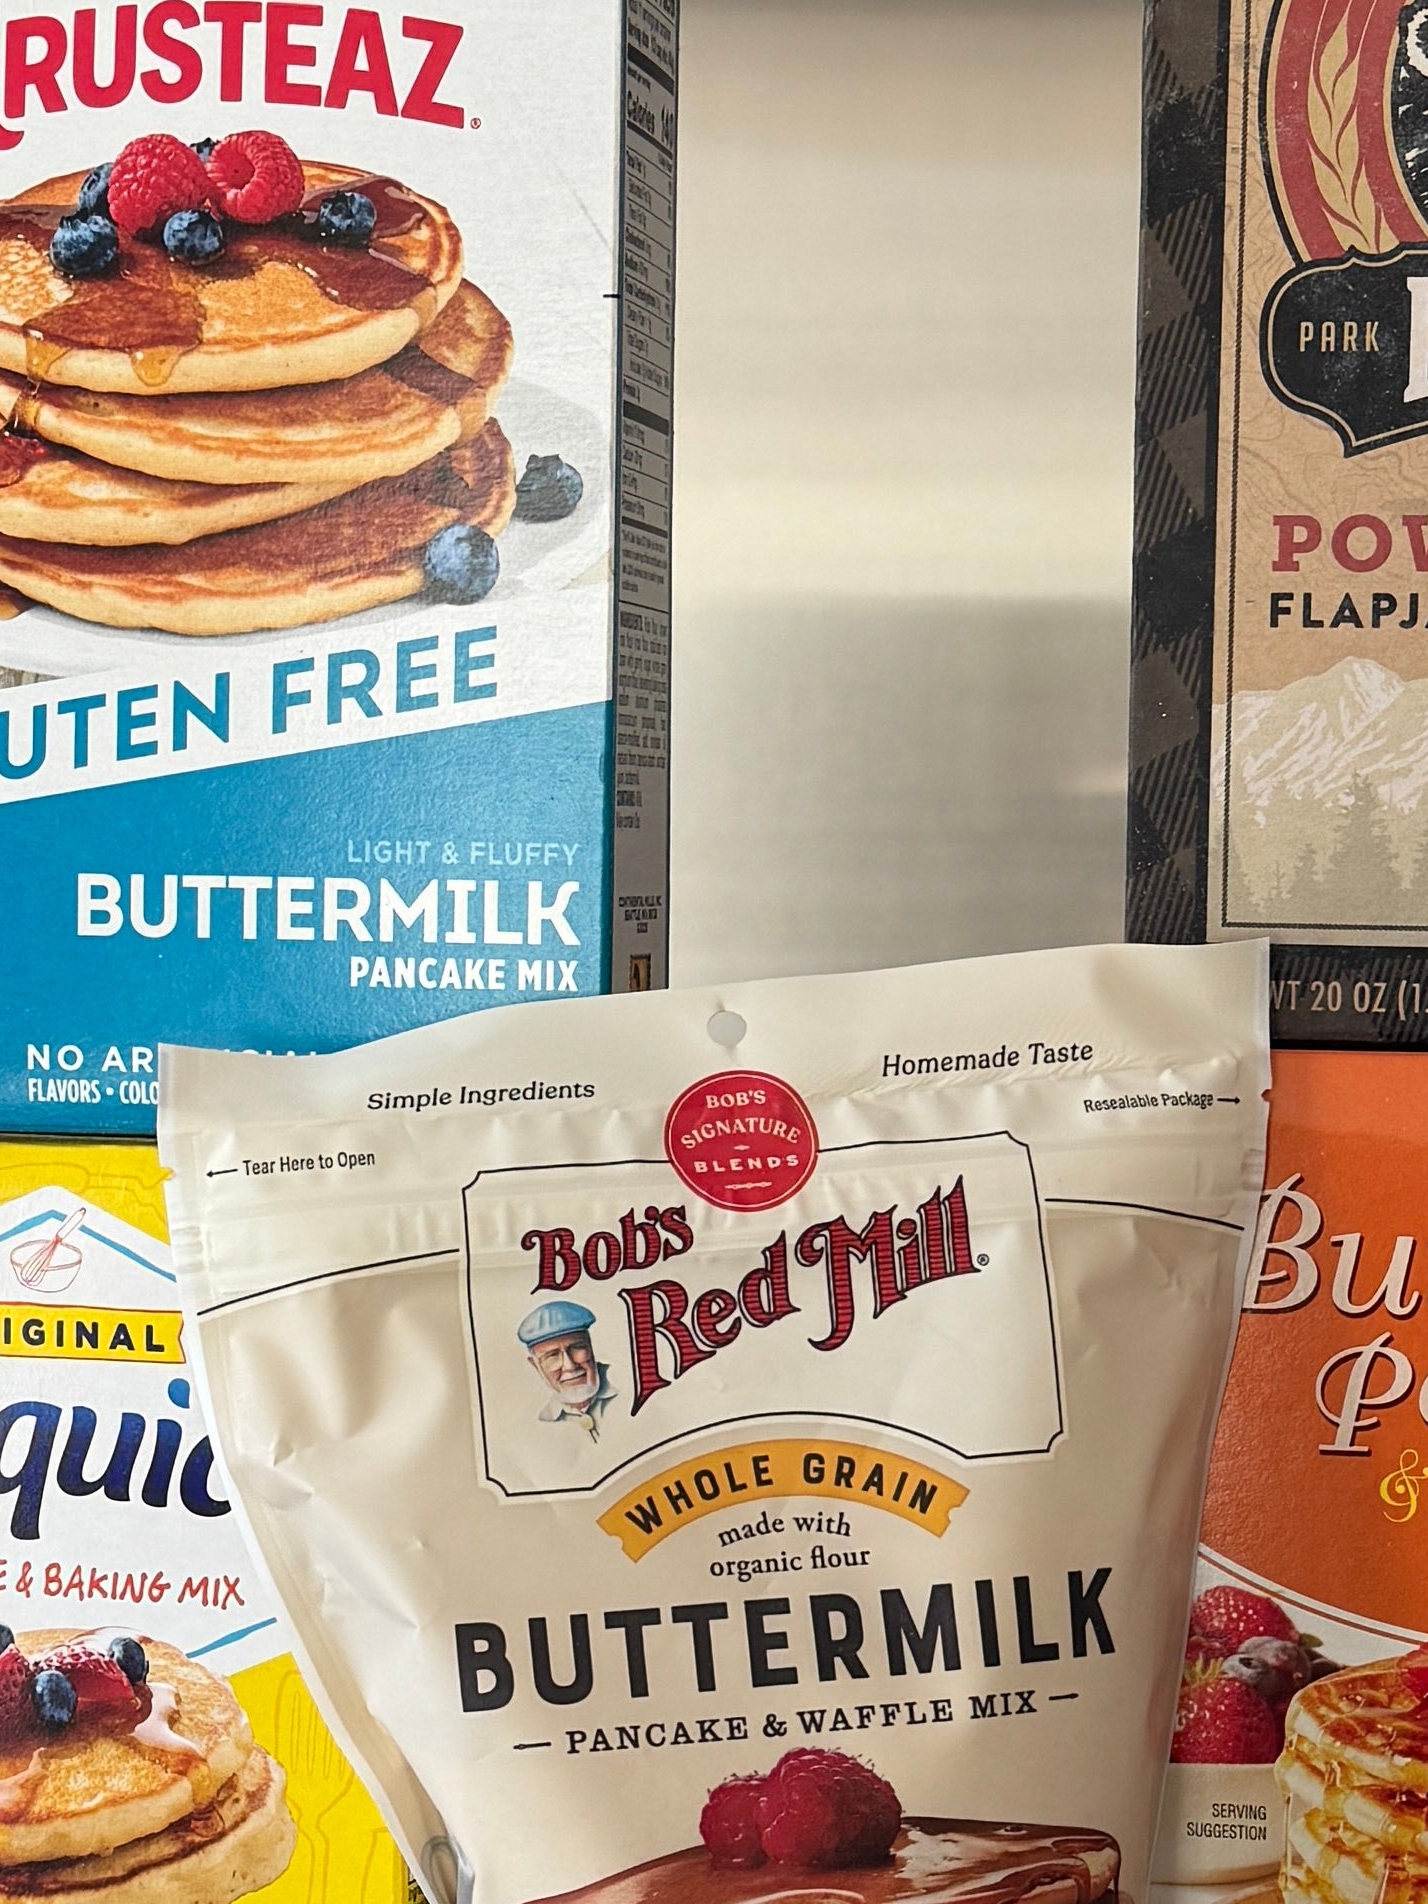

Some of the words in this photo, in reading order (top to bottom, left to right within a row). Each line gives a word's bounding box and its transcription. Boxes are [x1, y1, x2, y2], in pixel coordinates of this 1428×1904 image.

[1299, 320, 1381, 354] PARK
[270, 626, 500, 735] FREE
[347, 839, 431, 865] LIGHT
[442, 841, 460, 865] &
[469, 841, 580, 866] FLUFFY
[76, 872, 582, 946] BUTTERMILK
[350, 956, 507, 991] PANCAKE
[517, 958, 579, 992] MIX
[27, 1044, 85, 1072] NO
[882, 1047, 1021, 1079] Homemade
[1027, 1041, 1094, 1068] Taste
[28, 1078, 100, 1104] FLAVORS
[368, 1086, 453, 1113] Simple
[459, 1079, 596, 1107] Ingredients
[704, 1088, 768, 1111] BOB'S
[680, 1117, 804, 1150] SIGNATURE
[693, 1152, 801, 1175] BLENDS
[521, 1200, 695, 1299] Bob's
[622, 1231, 801, 1417] Red
[796, 1174, 977, 1353] Mill
[623, 1454, 775, 1534] WHOLE
[802, 1451, 939, 1516] GRAIN
[17, 1563, 31, 1597] &
[44, 1563, 172, 1604] BAKING
[179, 1575, 246, 1609] MIX
[455, 1567, 1117, 1714] BUTTERMILK
[566, 1716, 754, 1757] PANCAKE
[762, 1712, 788, 1741] &
[796, 1696, 956, 1736] WAFFLE
[970, 1690, 1040, 1721] MIX
[1211, 1801, 1268, 1822] SERVING
[1186, 1820, 1268, 1843] SUGGESTION
